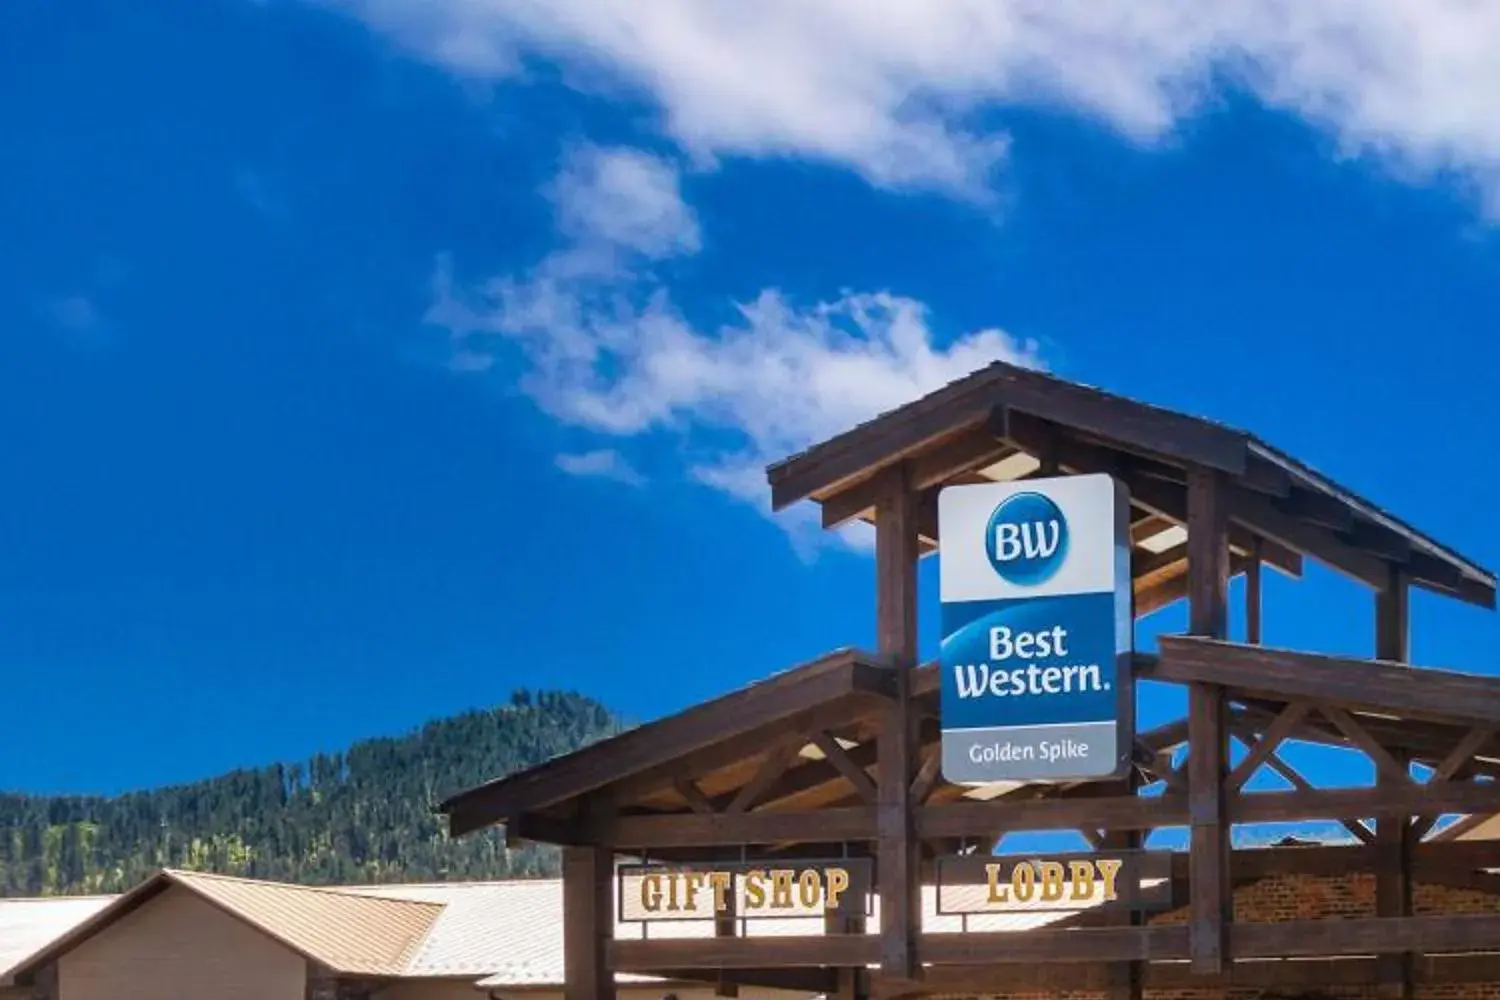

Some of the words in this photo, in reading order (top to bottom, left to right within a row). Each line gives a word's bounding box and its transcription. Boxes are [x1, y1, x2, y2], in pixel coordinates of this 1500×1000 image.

[995, 519, 1059, 562] BW
[989, 626, 1068, 660] Best
[969, 742, 1034, 763] Golden
[1039, 740, 1089, 762] Spike
[640, 871, 731, 911] GIFT
[744, 867, 849, 909] SHOP
[984, 859, 1123, 903] LOBBY
